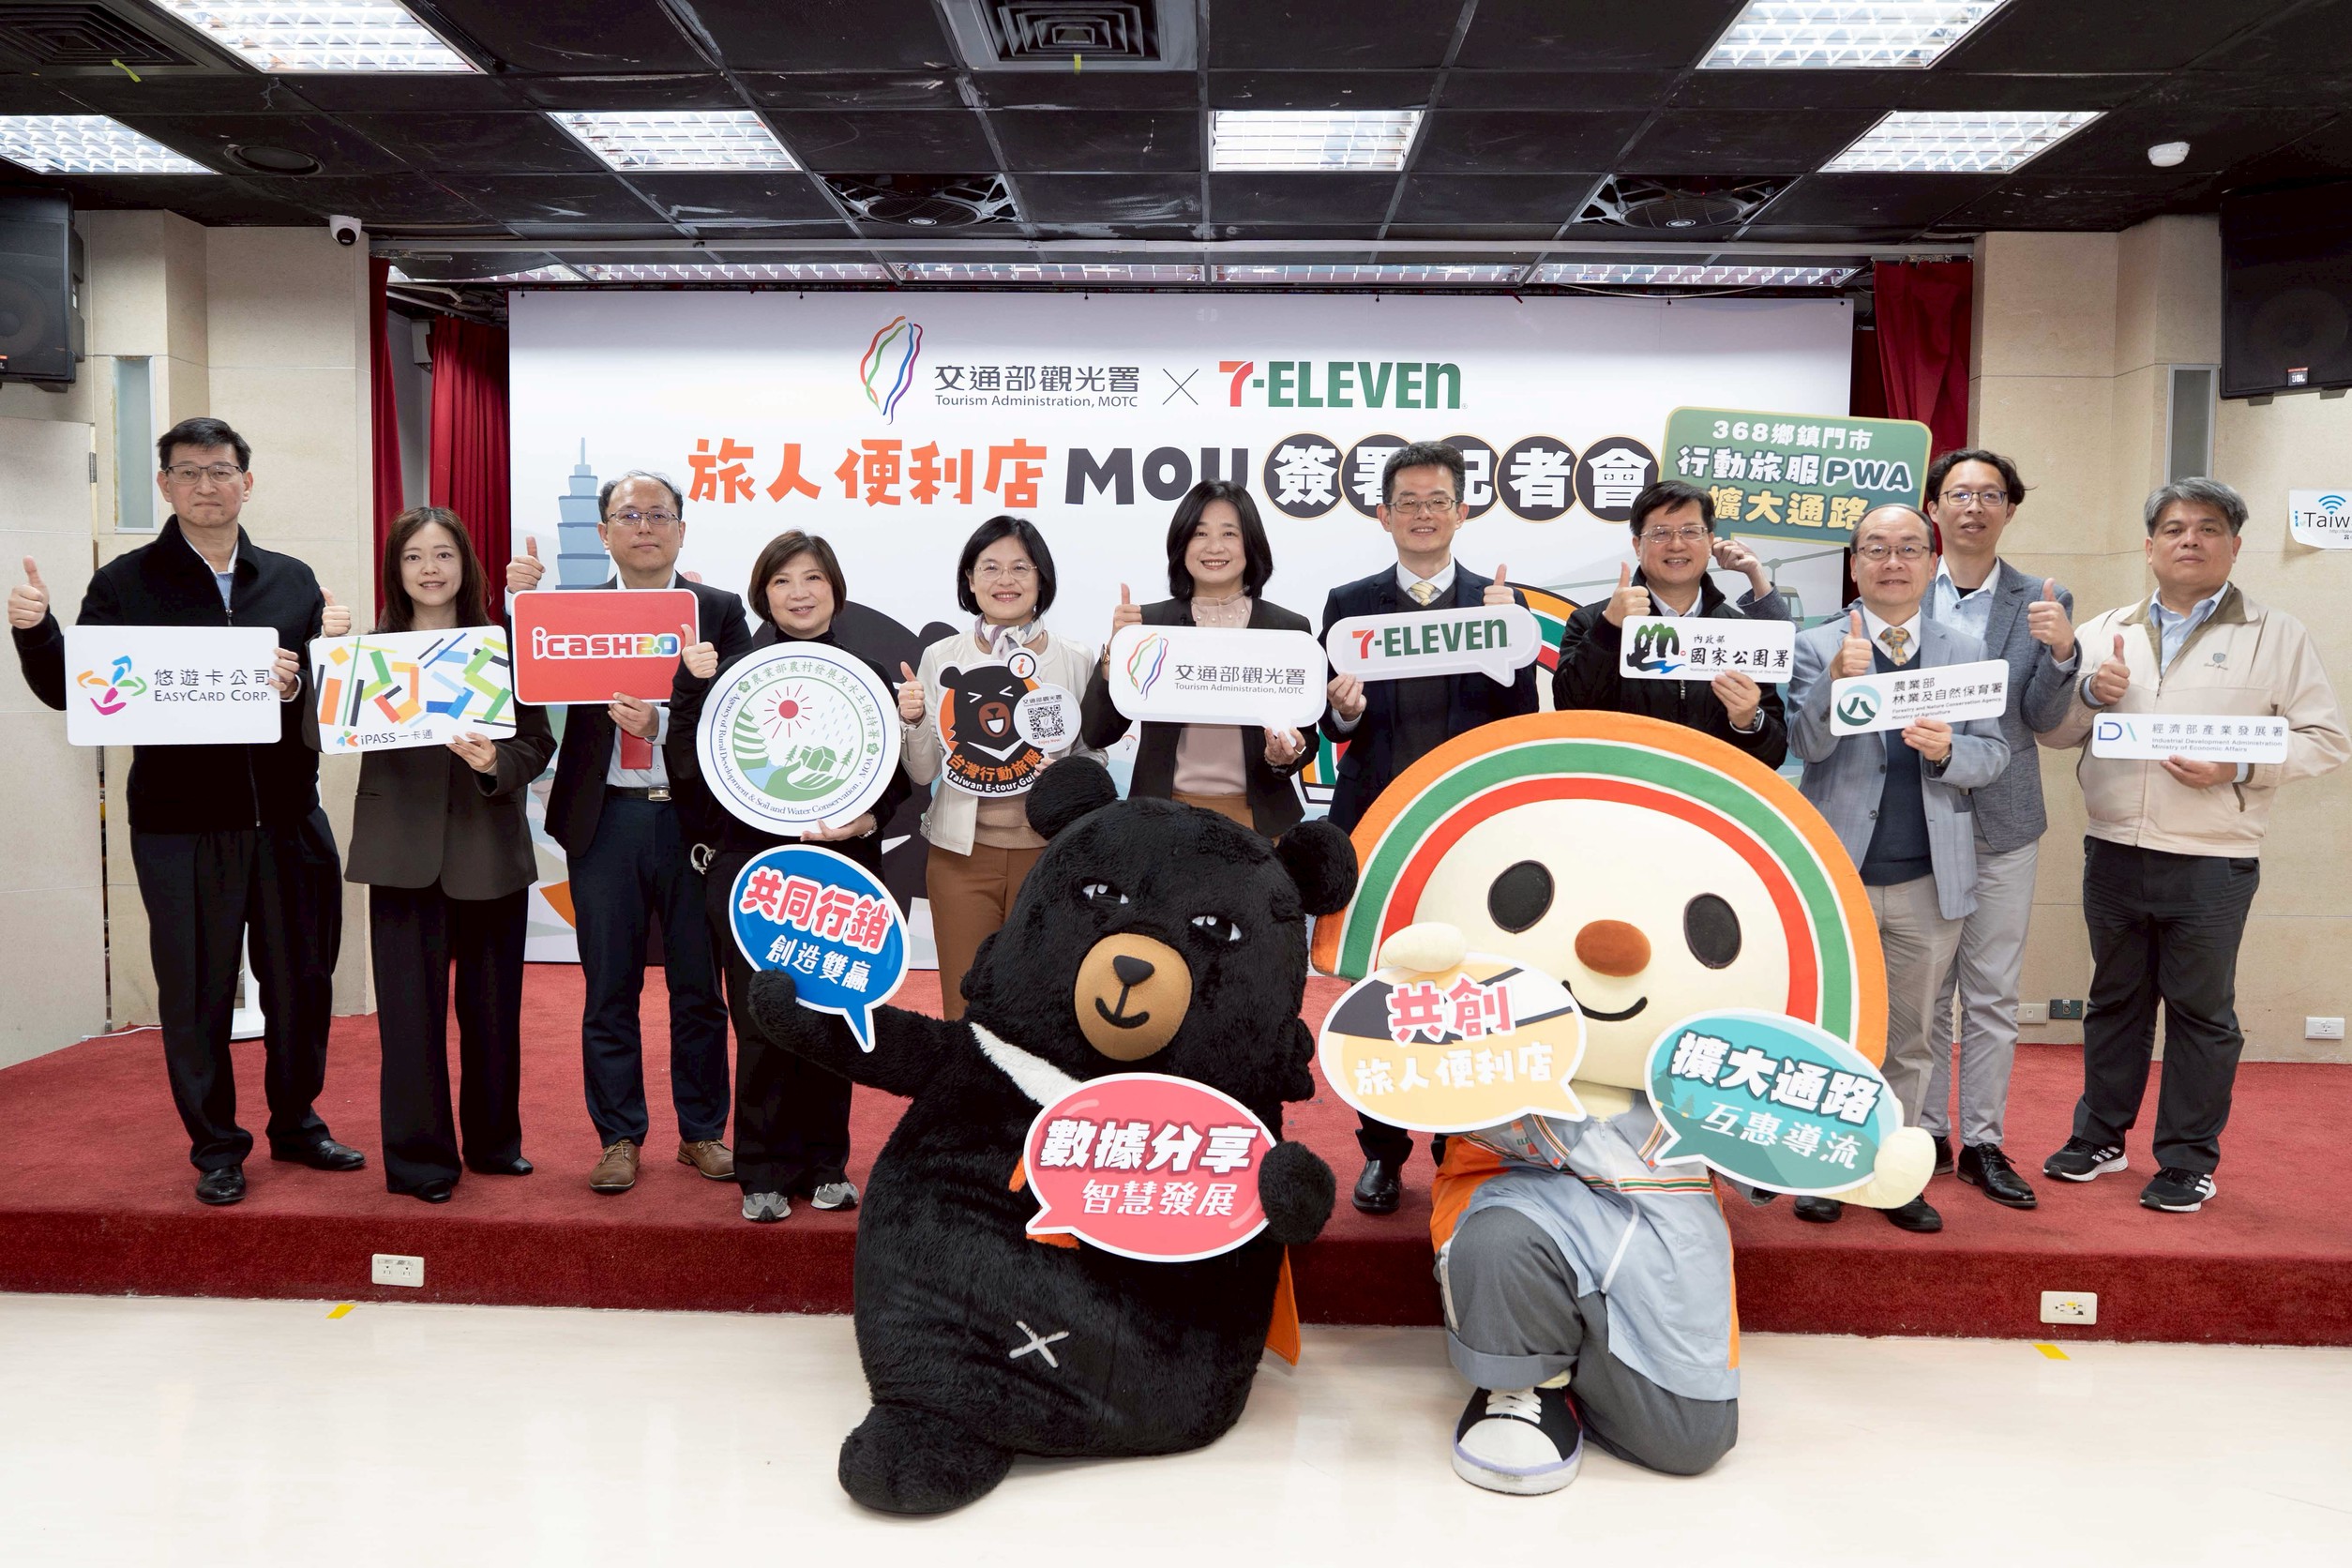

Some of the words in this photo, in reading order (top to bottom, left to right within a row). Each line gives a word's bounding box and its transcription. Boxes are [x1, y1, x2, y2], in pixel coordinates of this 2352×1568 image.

[934, 365, 1139, 393] 交通部觀光署
[935, 395, 988, 407] Tourism
[991, 395, 1095, 409] Administration,
[1098, 396, 1138, 408] MOTC
[1711, 419, 1874, 452] 368鄉鎮門市
[687, 437, 1048, 509] 旅人便利店
[1708, 484, 1870, 532] 擴大通路
[1690, 646, 1789, 668] 國家公園署
[154, 669, 270, 686] 悠遊卡公司
[1174, 683, 1209, 691] Tourism
[1210, 684, 1277, 695] Administration,
[1278, 686, 1304, 695] MOTC
[1175, 664, 1305, 686] 交通部觀光署
[1892, 676, 1936, 692] 農業部
[1892, 682, 2003, 705] 林業及自然保育署
[2151, 723, 2284, 737] 經濟部產業發展署
[947, 747, 1043, 782] 台灣行動旅服
[948, 770, 983, 791] Taiwan
[985, 781, 1018, 792] E-tour
[1018, 772, 1035, 786] Gui
[719, 750, 749, 798] Development
[755, 797, 770, 809] Soil
[769, 806, 786, 815] and
[786, 807, 812, 816] Water
[741, 869, 892, 951] 共同行銷
[764, 934, 872, 993] 創造雙贏
[1389, 976, 1513, 1043] 共創
[1353, 1040, 1555, 1096] 旅人便利店
[1669, 1031, 1882, 1126] 擴大通路
[1038, 1118, 1259, 1174] 數據分享
[1699, 1100, 1863, 1170] 互惠導流
[1081, 1178, 1238, 1217] 智慧發展
